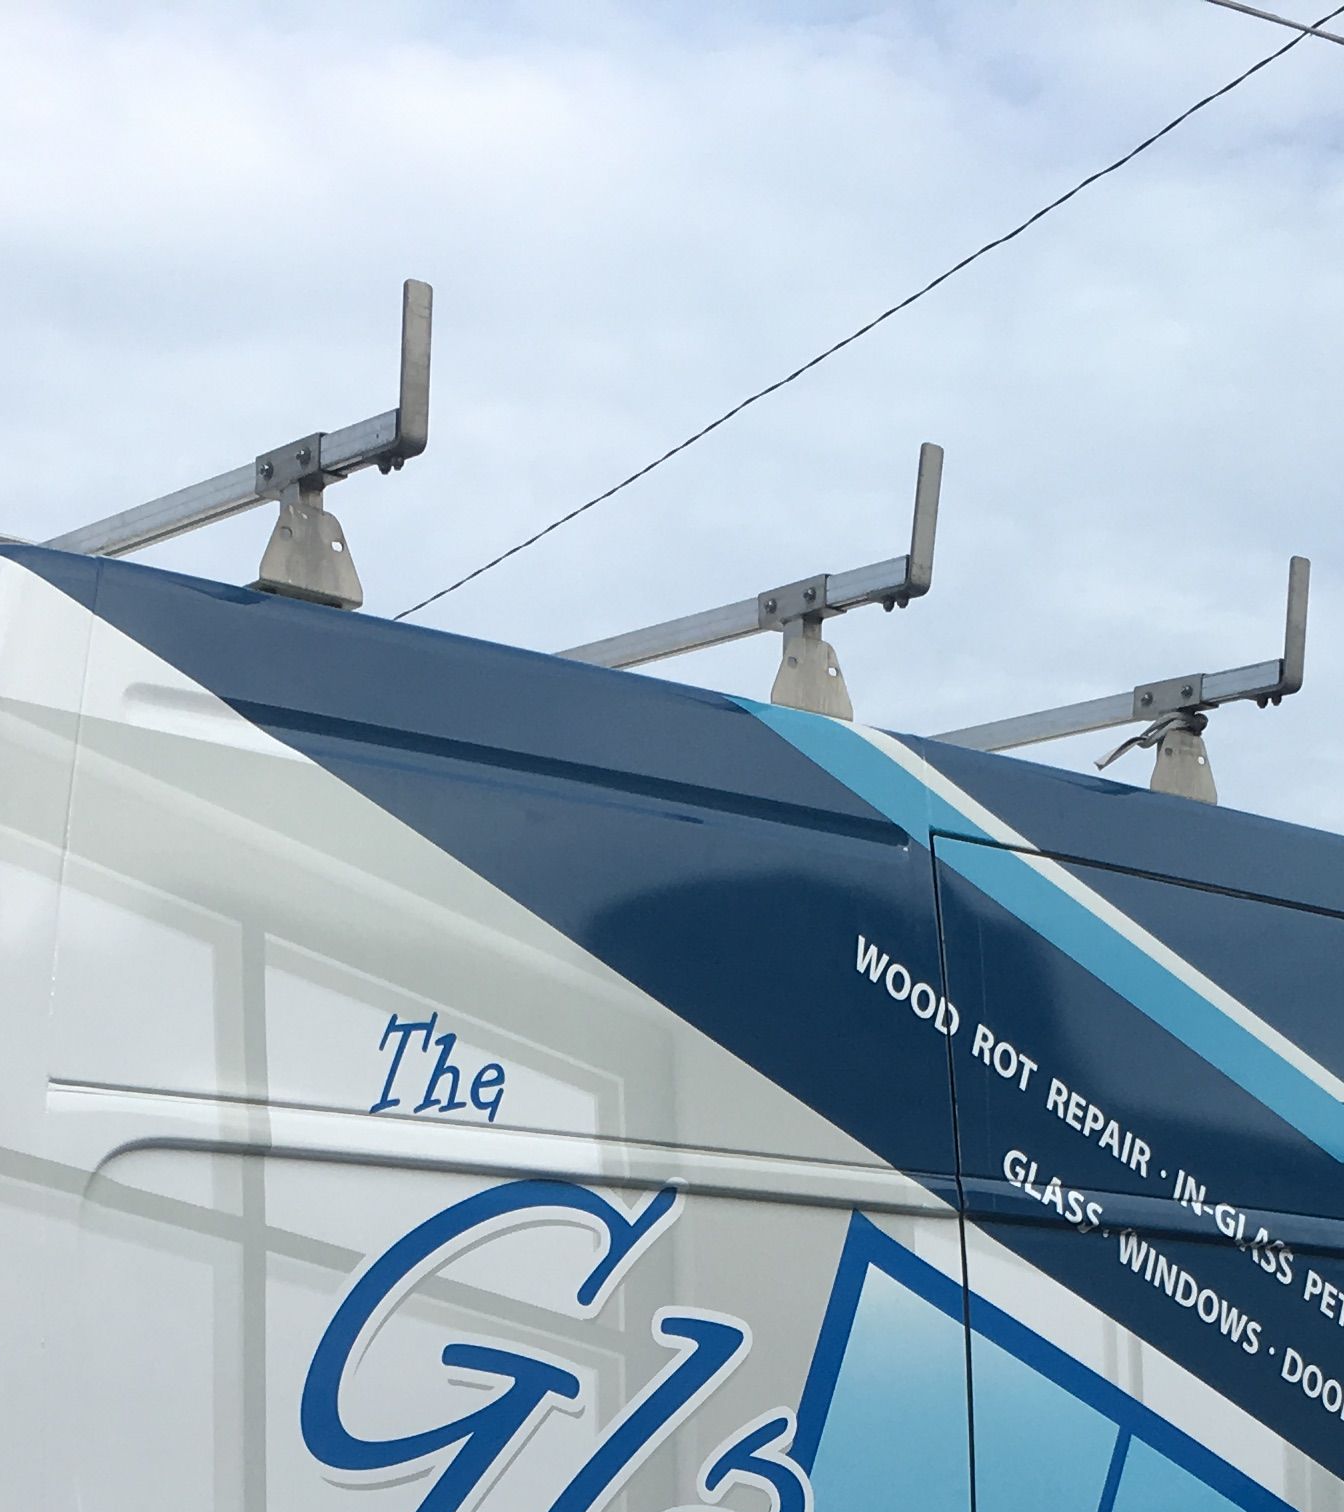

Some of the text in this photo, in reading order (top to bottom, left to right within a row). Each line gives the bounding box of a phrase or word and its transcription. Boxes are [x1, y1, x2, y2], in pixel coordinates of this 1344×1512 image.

[368, 1011, 507, 1123] The
[855, 934, 960, 1037] WOOD
[972, 1023, 1038, 1092] ROT
[1046, 1077, 1152, 1179] REPAIR
[1173, 1169, 1294, 1285] IN-GLASS
[1003, 1149, 1103, 1236] GLASS
[1119, 1228, 1263, 1355] WINDOWS
